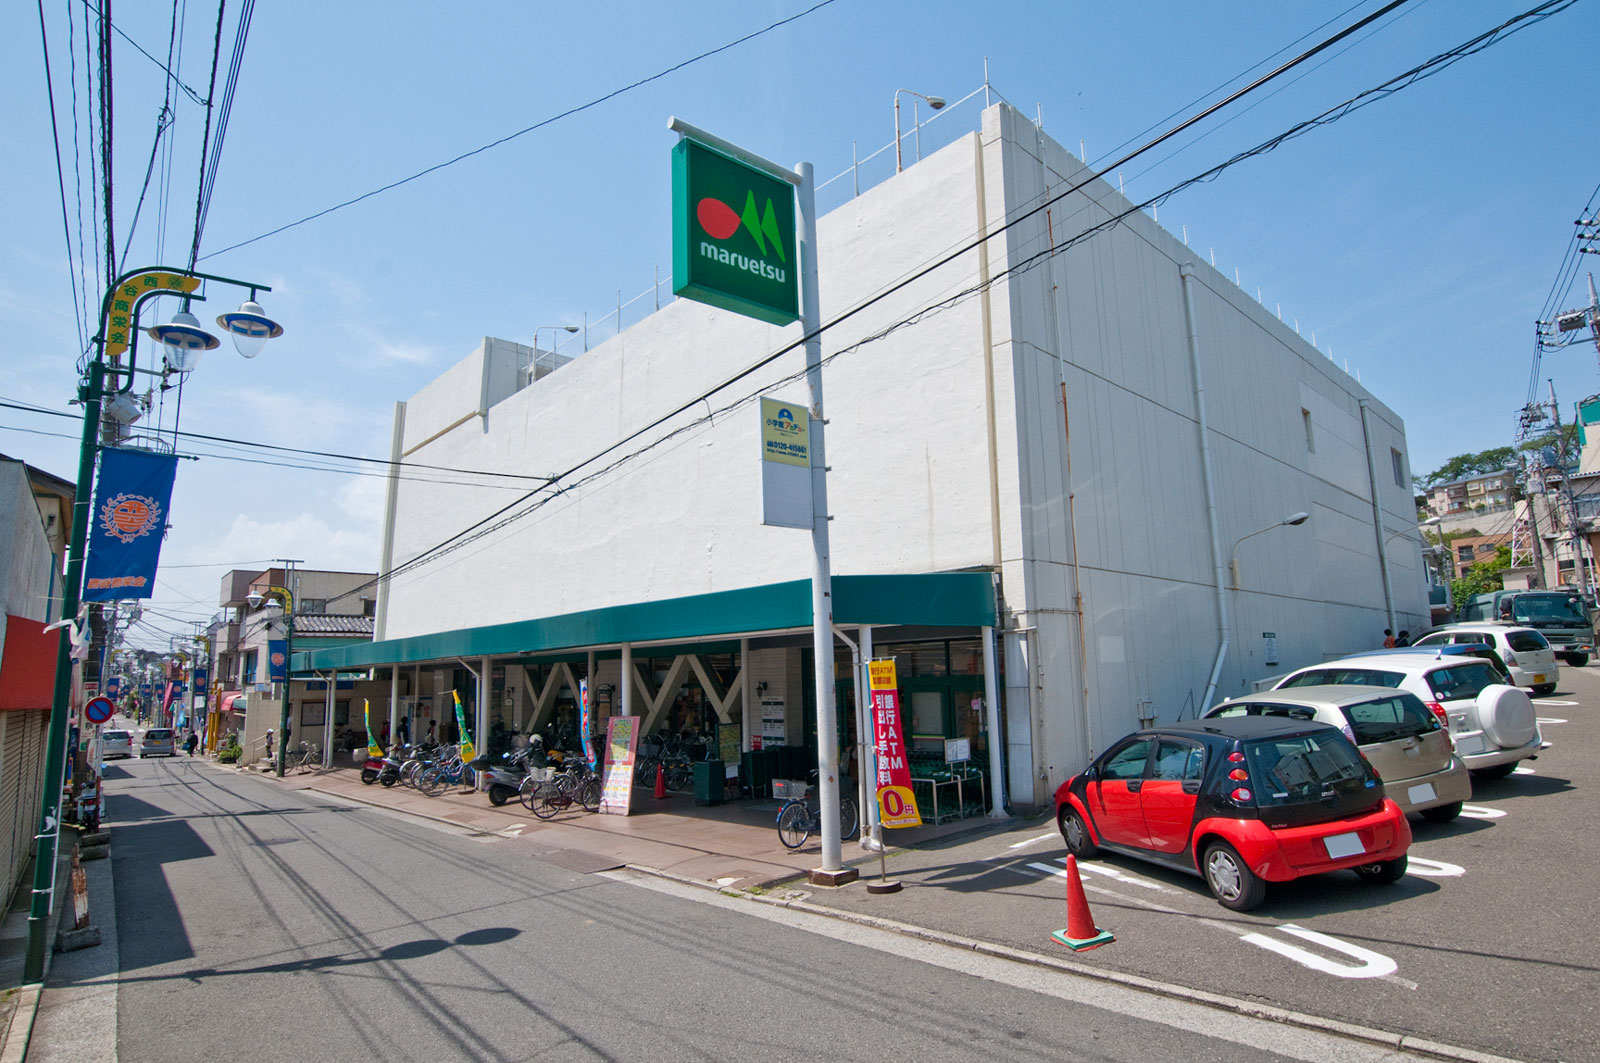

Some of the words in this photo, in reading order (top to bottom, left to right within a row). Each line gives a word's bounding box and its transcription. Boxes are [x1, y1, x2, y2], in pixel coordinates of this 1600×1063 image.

[701, 242, 785, 283] maruetsu
[111, 275, 158, 345] 西谷商栄会
[876, 694, 892, 786] 引出し手数料
[885, 694, 903, 770] 銀行ATM
[883, 789, 915, 817] 0円
